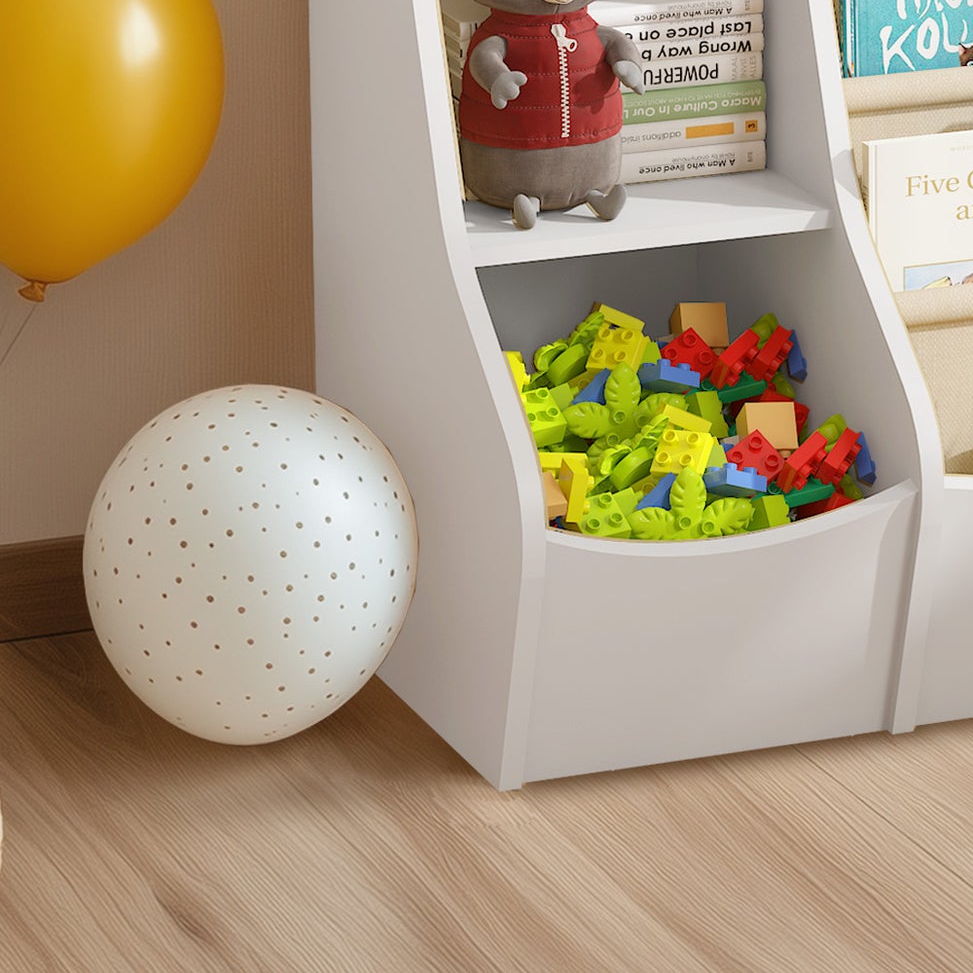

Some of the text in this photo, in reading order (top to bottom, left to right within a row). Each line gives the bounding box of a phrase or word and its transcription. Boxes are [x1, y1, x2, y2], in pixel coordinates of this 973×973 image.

[660, 11, 681, 20] lived
[683, 10, 701, 18] who
[704, 8, 724, 16] Man
[634, 14, 658, 22] once
[666, 21, 714, 38] place
[720, 21, 752, 35] Last
[639, 30, 660, 41] on
[699, 40, 752, 53] Wrong
[657, 45, 692, 59] way
[643, 63, 719, 86] POWERFU
[673, 100, 718, 112] Culture
[721, 96, 762, 107] Macro
[632, 108, 655, 117] Our
[659, 106, 670, 115] In
[642, 131, 682, 141] additions
[639, 166, 662, 174] once
[663, 163, 685, 172] lived
[686, 161, 705, 169] who
[905, 174, 960, 198] Five
